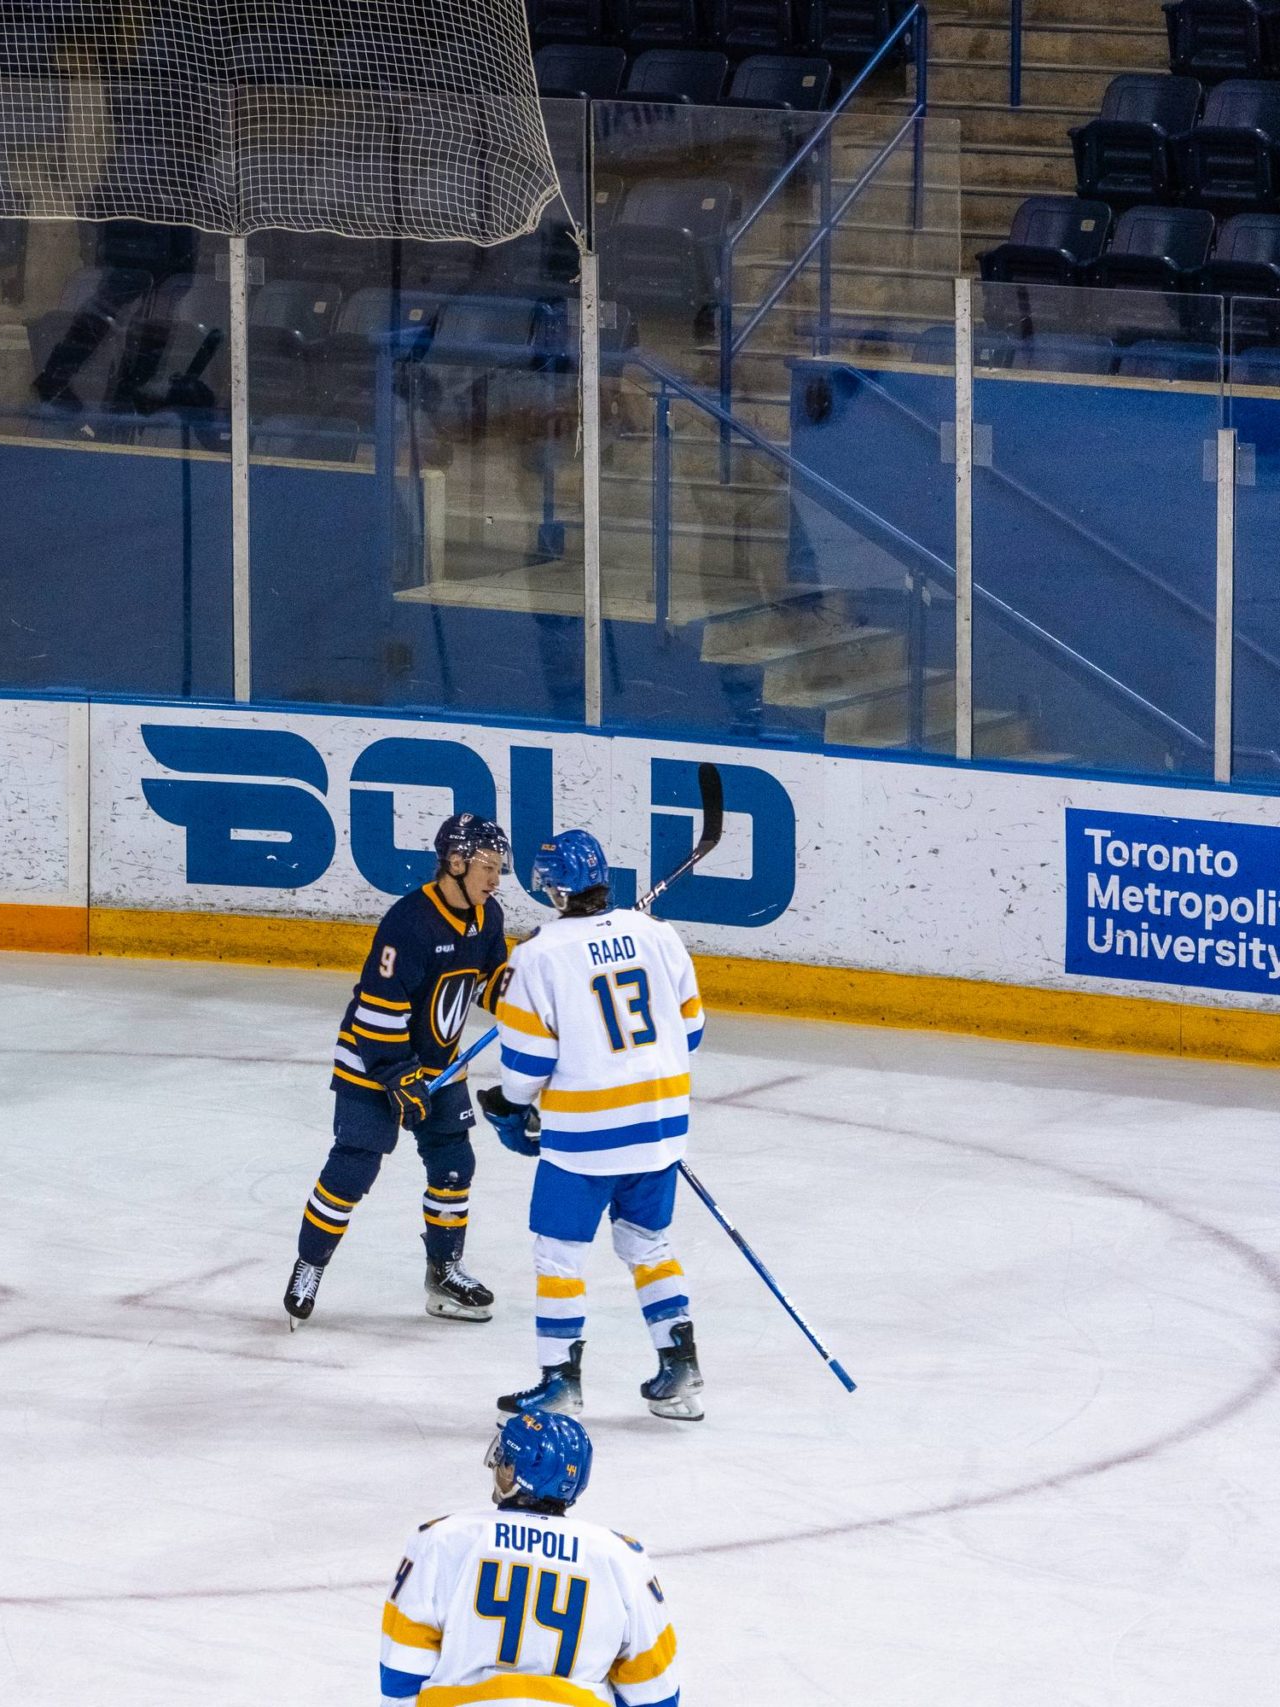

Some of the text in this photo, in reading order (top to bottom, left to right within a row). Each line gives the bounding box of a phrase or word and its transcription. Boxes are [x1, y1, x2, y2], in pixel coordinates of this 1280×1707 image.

[140, 724, 795, 928] BOLD
[1084, 828, 1239, 878] Toronto
[1087, 872, 1280, 931] Metropoli
[379, 945, 397, 978] 9
[588, 935, 636, 966] RAAD
[1087, 916, 1280, 980] University
[590, 966, 657, 1053] 13
[506, 1439, 521, 1451] CCM
[566, 1464, 577, 1477] 44
[495, 1522, 579, 1563] RUPOLI
[474, 1559, 590, 1679] 44
